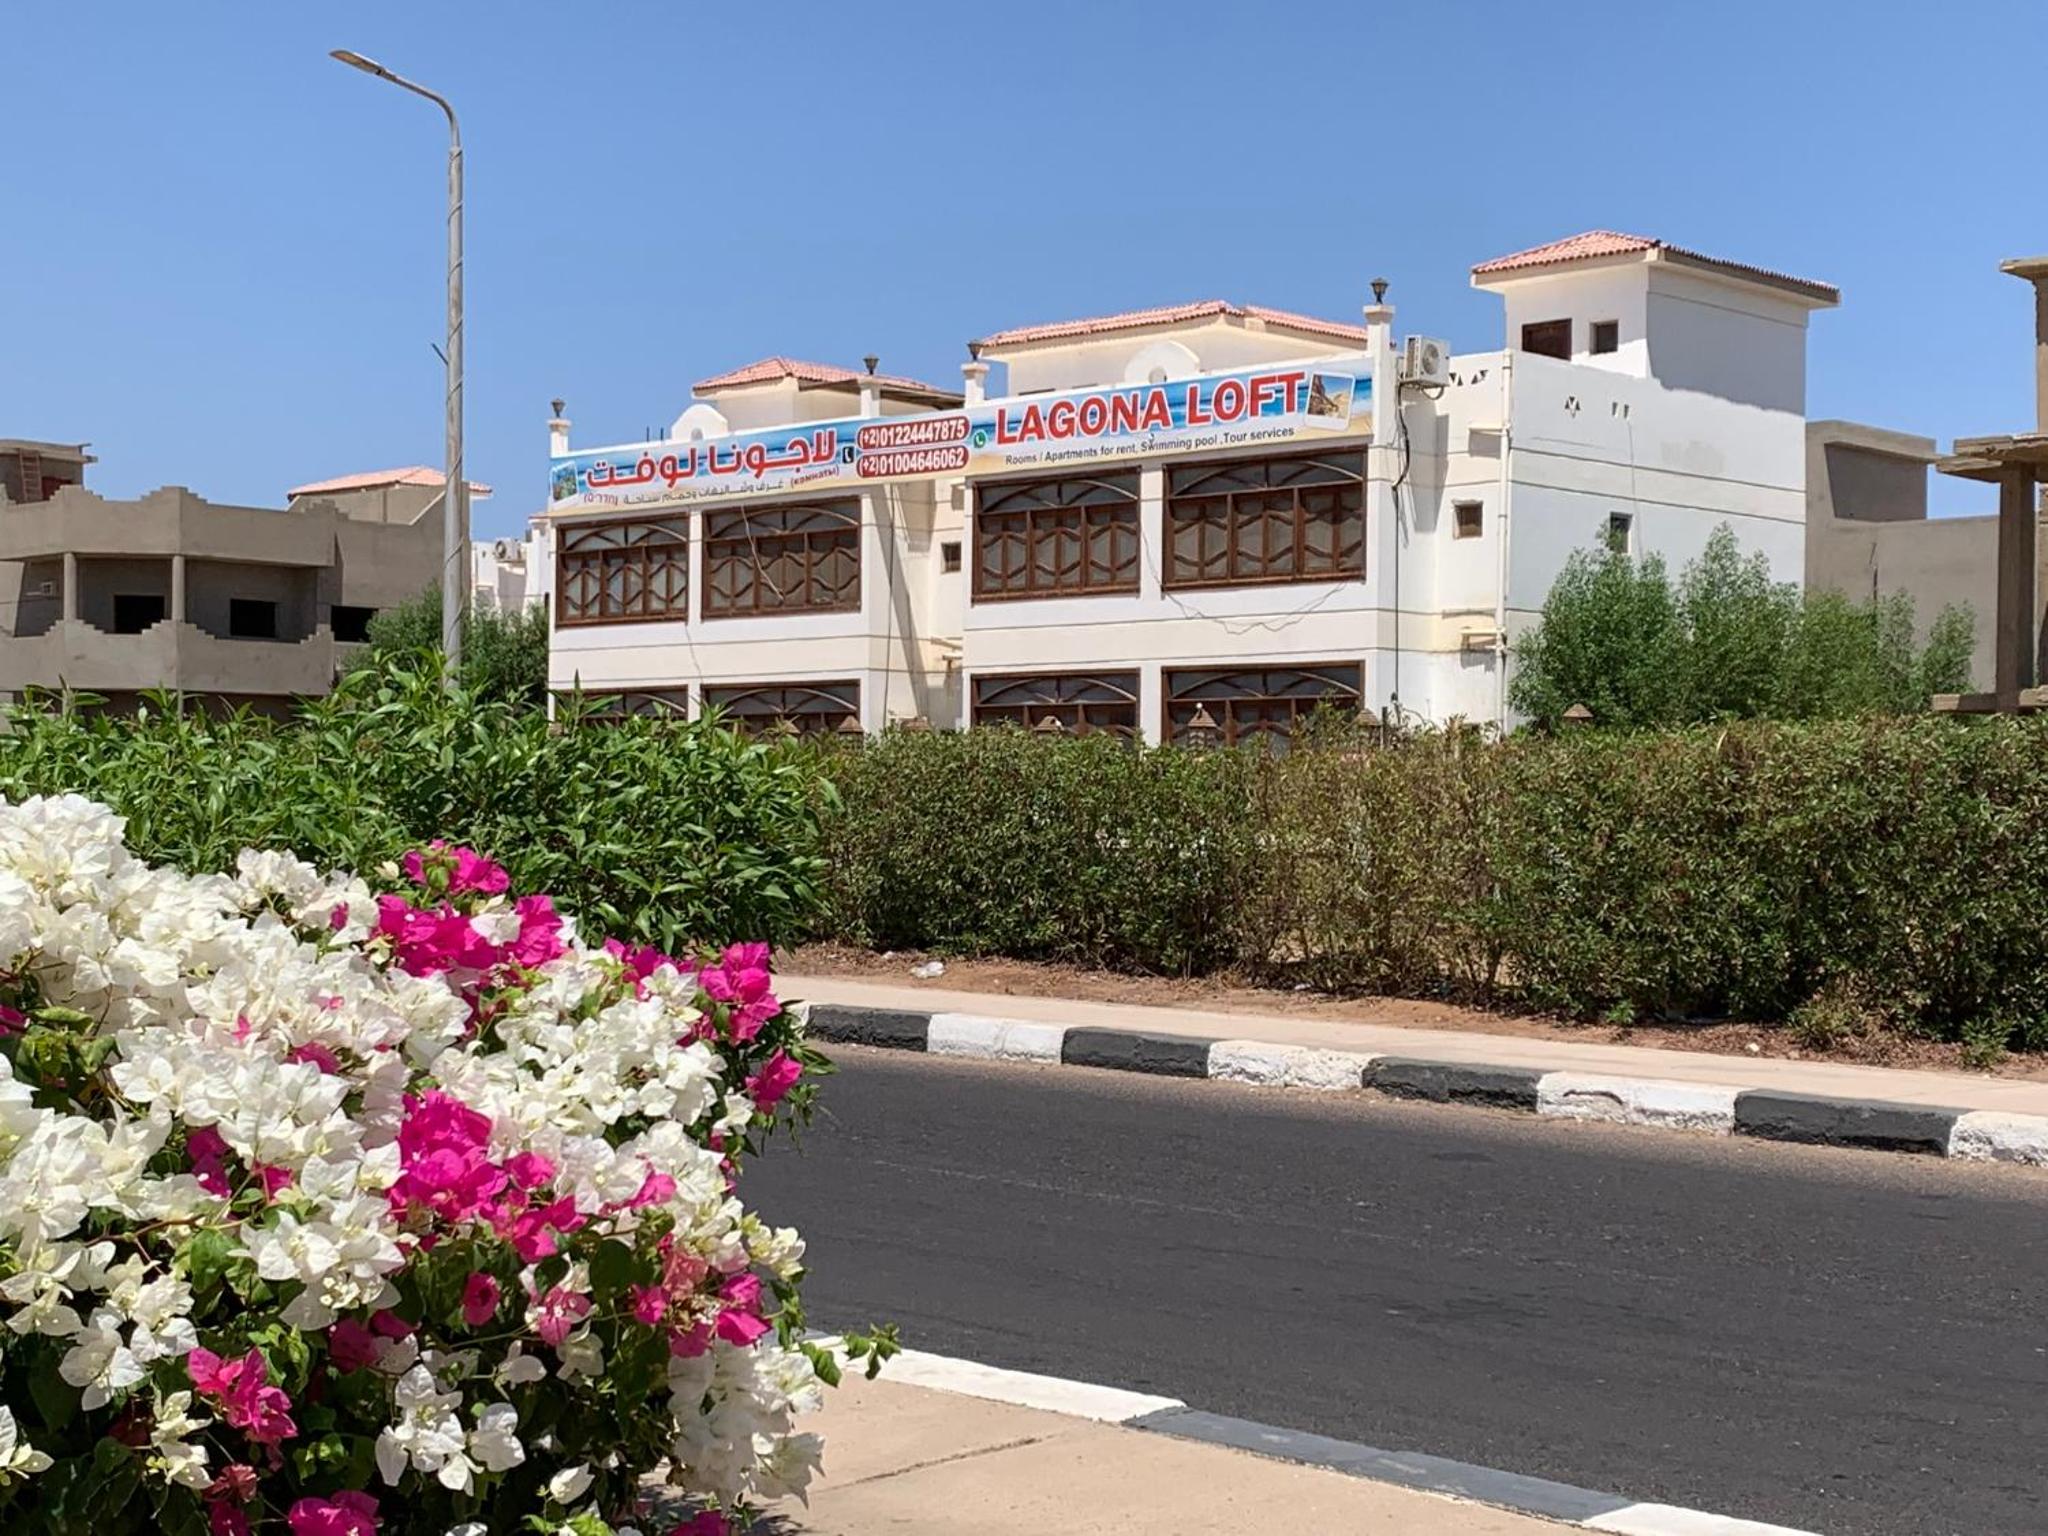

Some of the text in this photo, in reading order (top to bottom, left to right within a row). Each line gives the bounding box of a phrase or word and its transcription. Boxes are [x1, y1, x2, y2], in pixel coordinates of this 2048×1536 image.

[998, 372, 1305, 444] LAGONA LOFT
[860, 420, 965, 445] (+2)01224447875
[1005, 455, 1037, 465] Rooms
[1044, 447, 1098, 463] Apartments
[1101, 445, 1114, 455] for
[1140, 437, 1192, 452] Swimming
[1195, 434, 1217, 447] pool
[1250, 427, 1294, 440] services
[587, 430, 835, 488] لاجونا لوفت
[860, 448, 964, 475] (+2)01004646062
